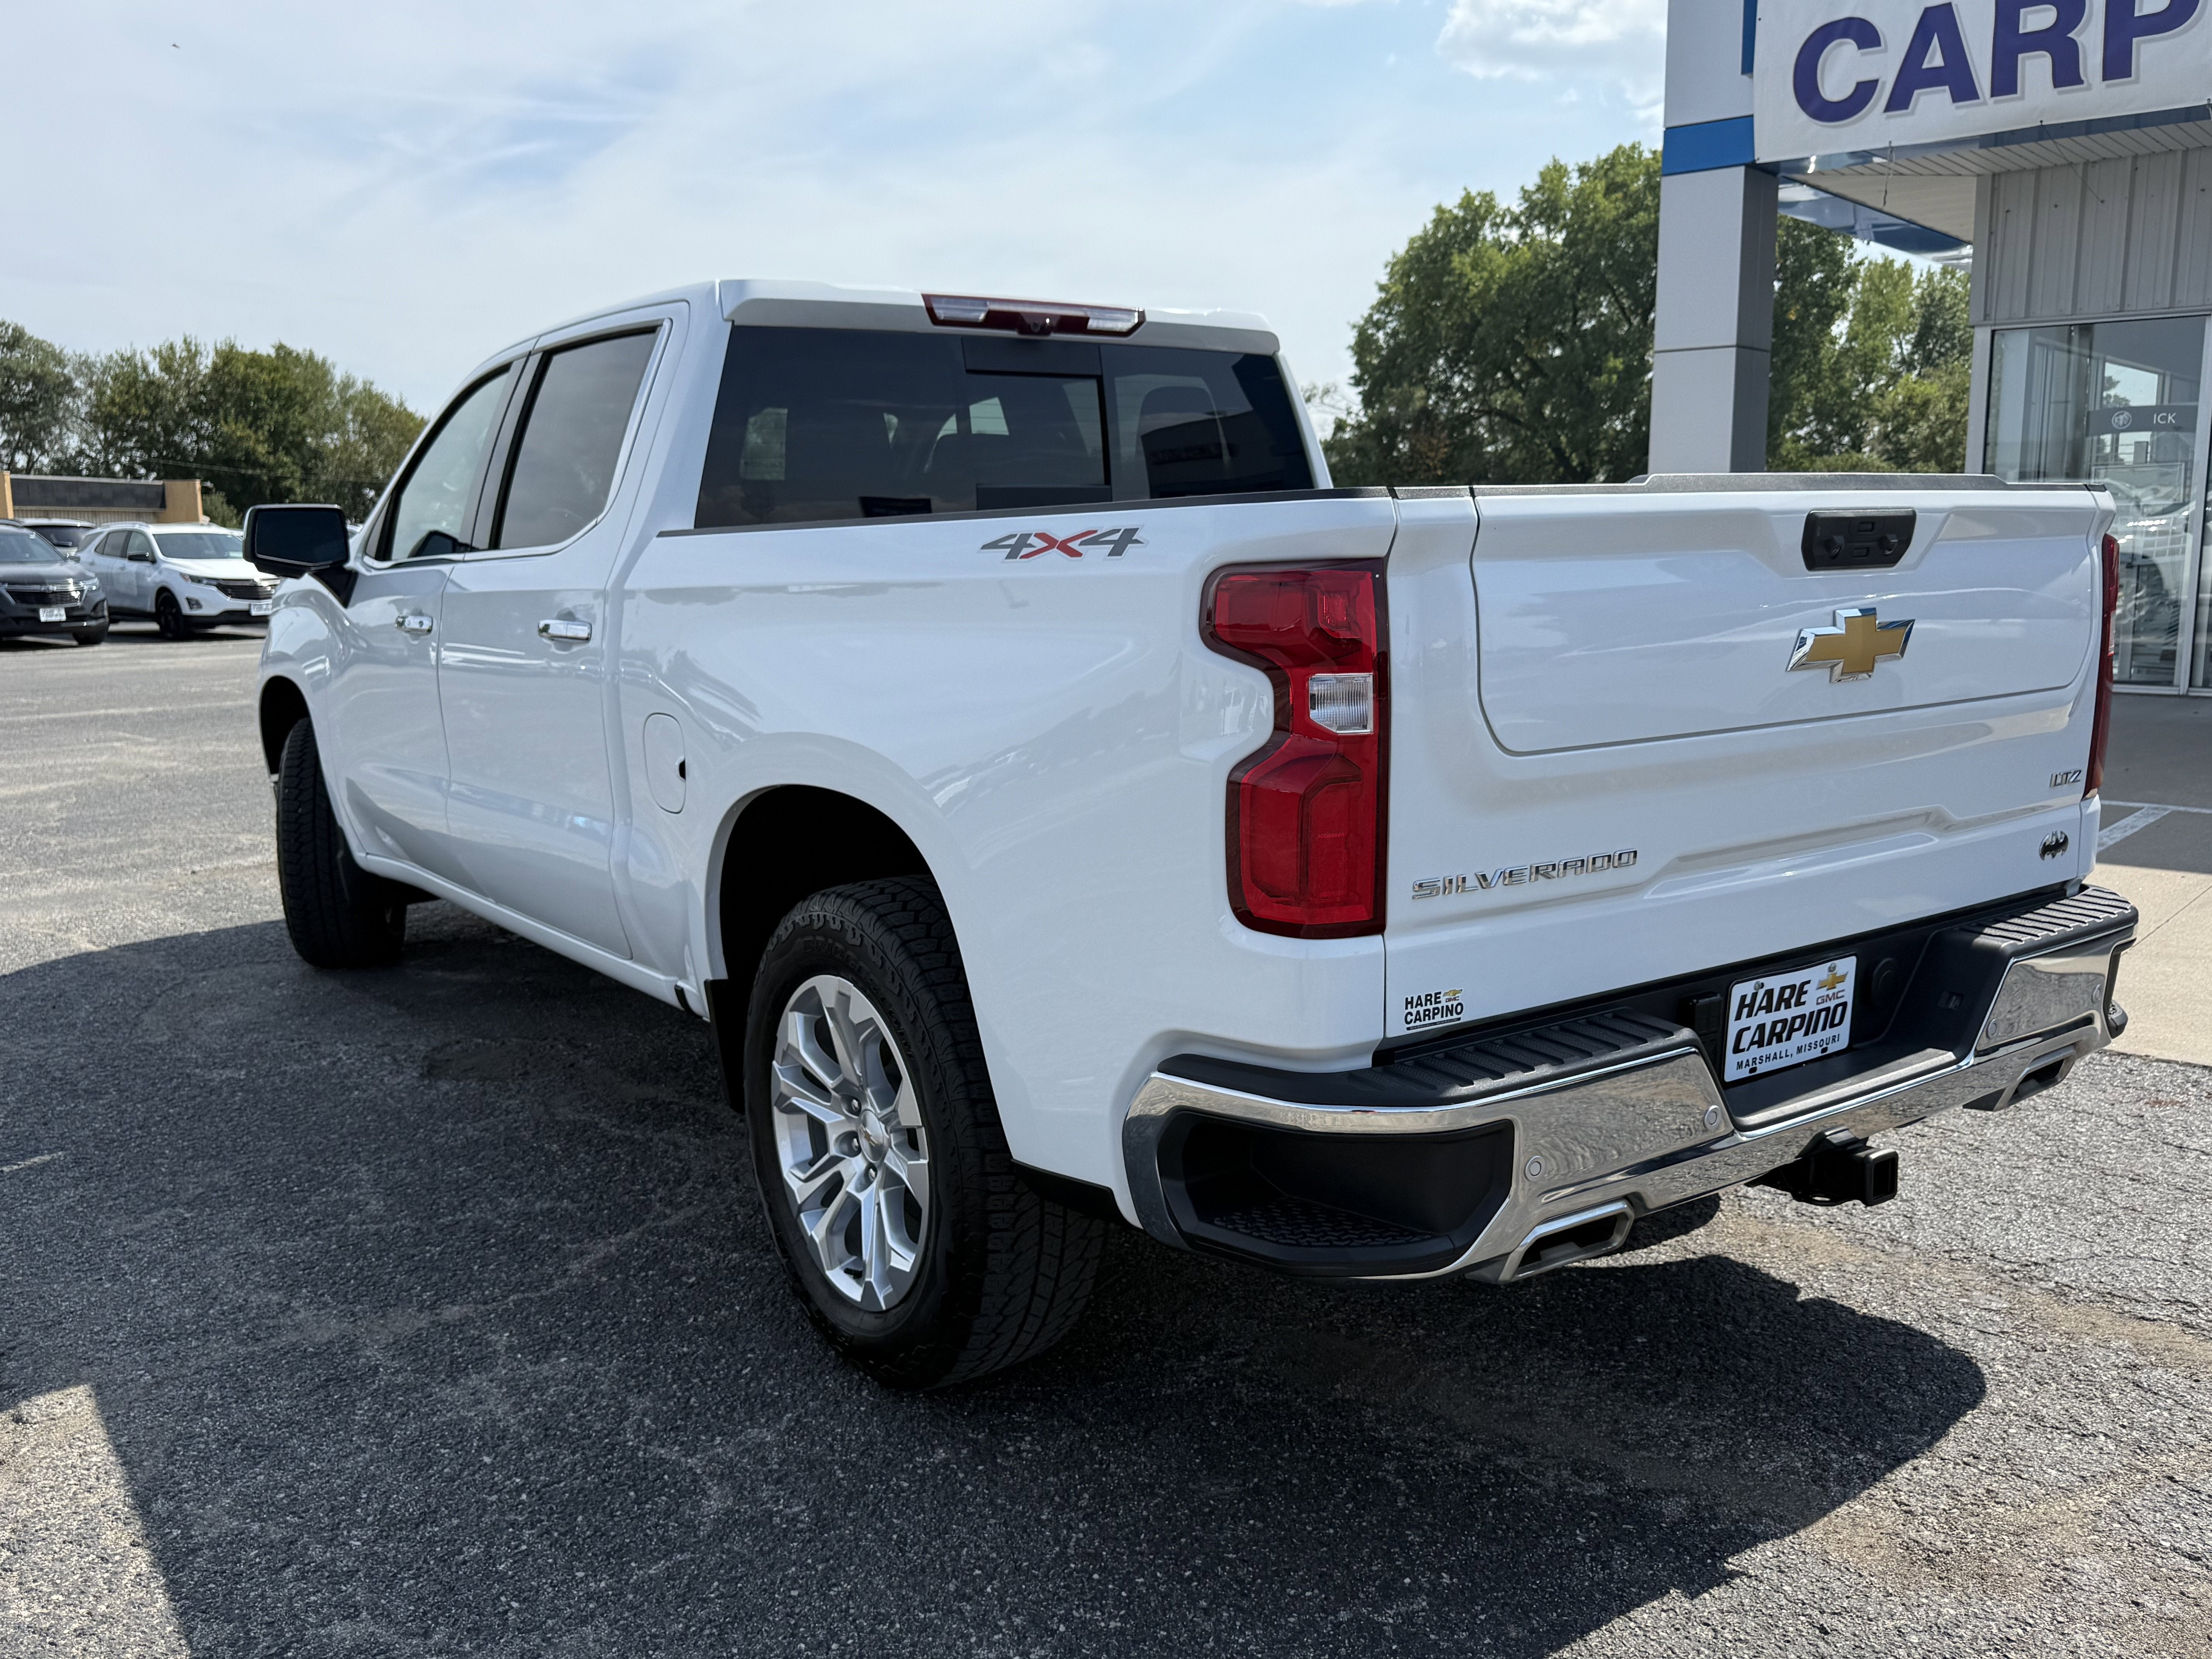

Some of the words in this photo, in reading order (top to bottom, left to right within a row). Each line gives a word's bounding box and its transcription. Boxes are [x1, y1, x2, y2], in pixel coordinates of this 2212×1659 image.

[1793, 0, 2200, 123] CARP
[2154, 412, 2176, 424] ICK
[2049, 769, 2082, 788] LTZ
[1412, 848, 1638, 900] SILVERADO
[1405, 991, 1441, 1010] HARE
[1734, 980, 1811, 1022] HARE
[1816, 989, 1845, 1006] GMC
[1404, 1002, 1463, 1025] CARPINO
[1732, 1001, 1848, 1054] CARPINO
[1736, 1049, 1793, 1070] MARSHALL,
[1796, 1034, 1840, 1055] MISSOURI
